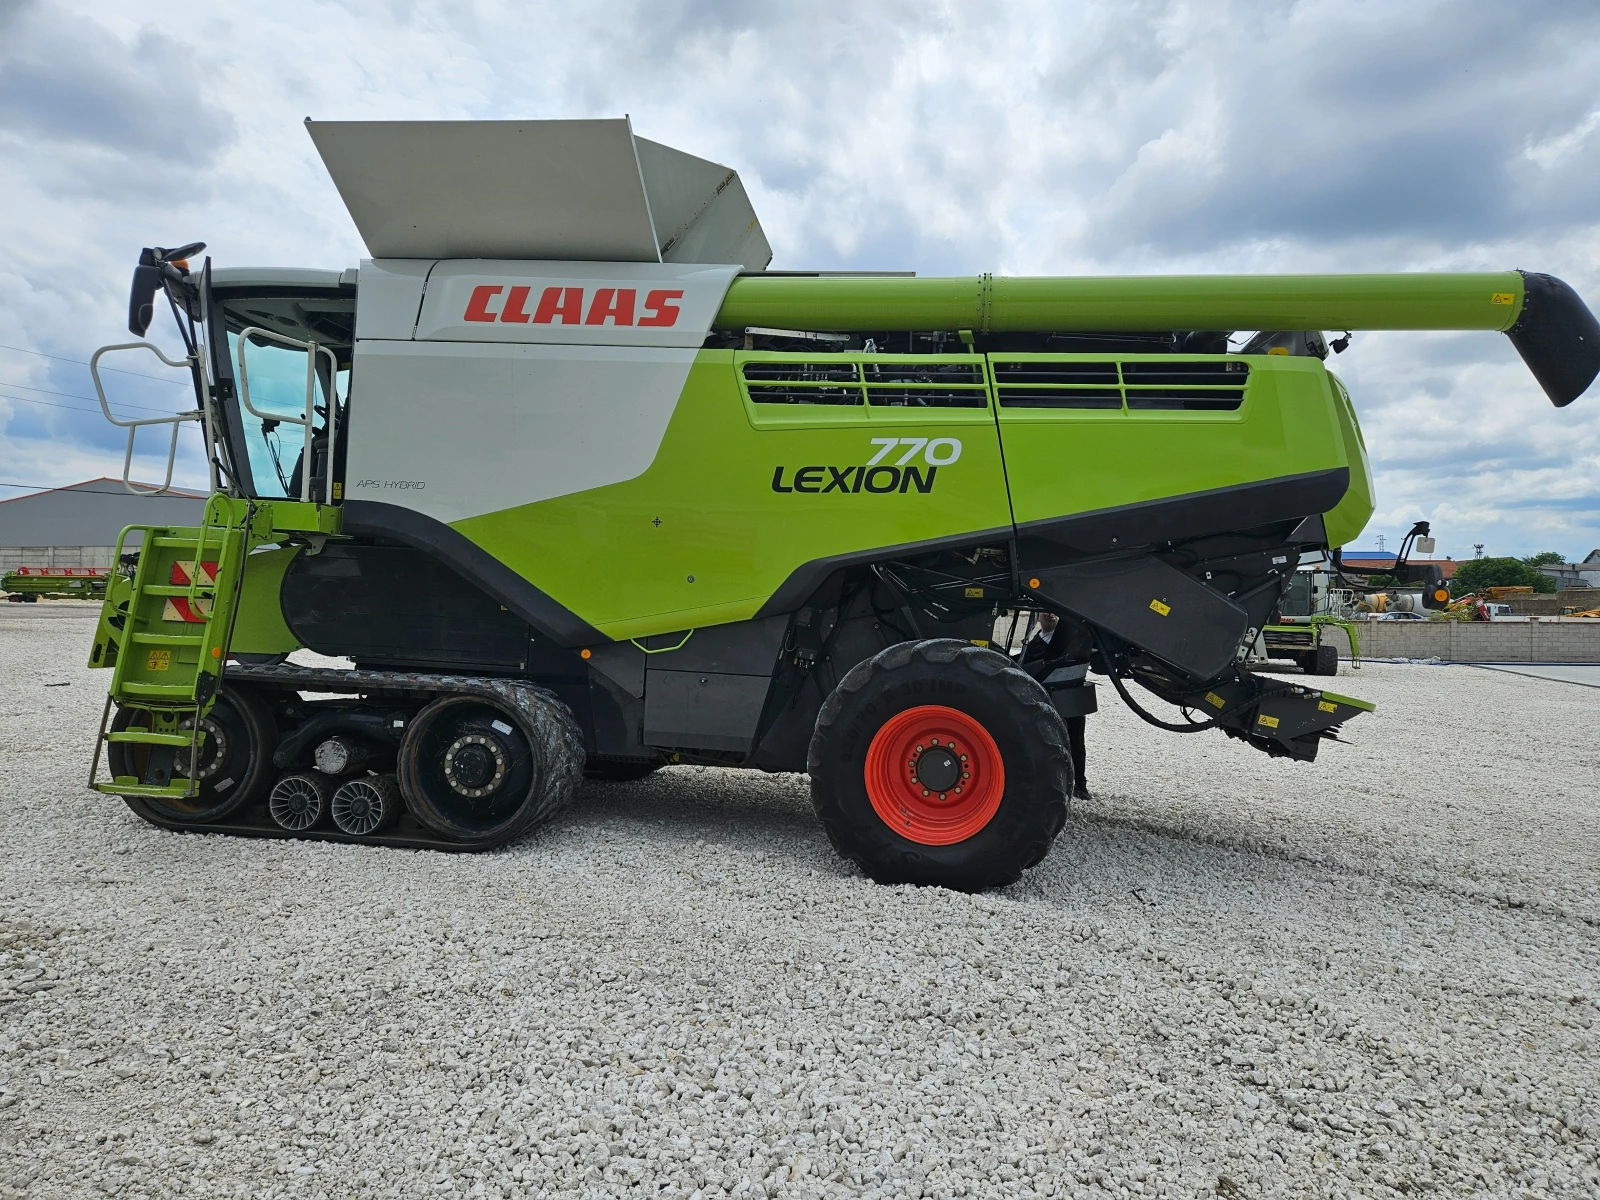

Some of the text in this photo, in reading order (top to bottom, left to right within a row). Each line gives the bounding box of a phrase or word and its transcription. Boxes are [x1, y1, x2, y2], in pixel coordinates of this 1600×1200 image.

[464, 286, 682, 327] CLAAS
[866, 437, 962, 466] 770
[356, 479, 426, 490] APS HYBRID
[771, 465, 937, 494] LEXION
